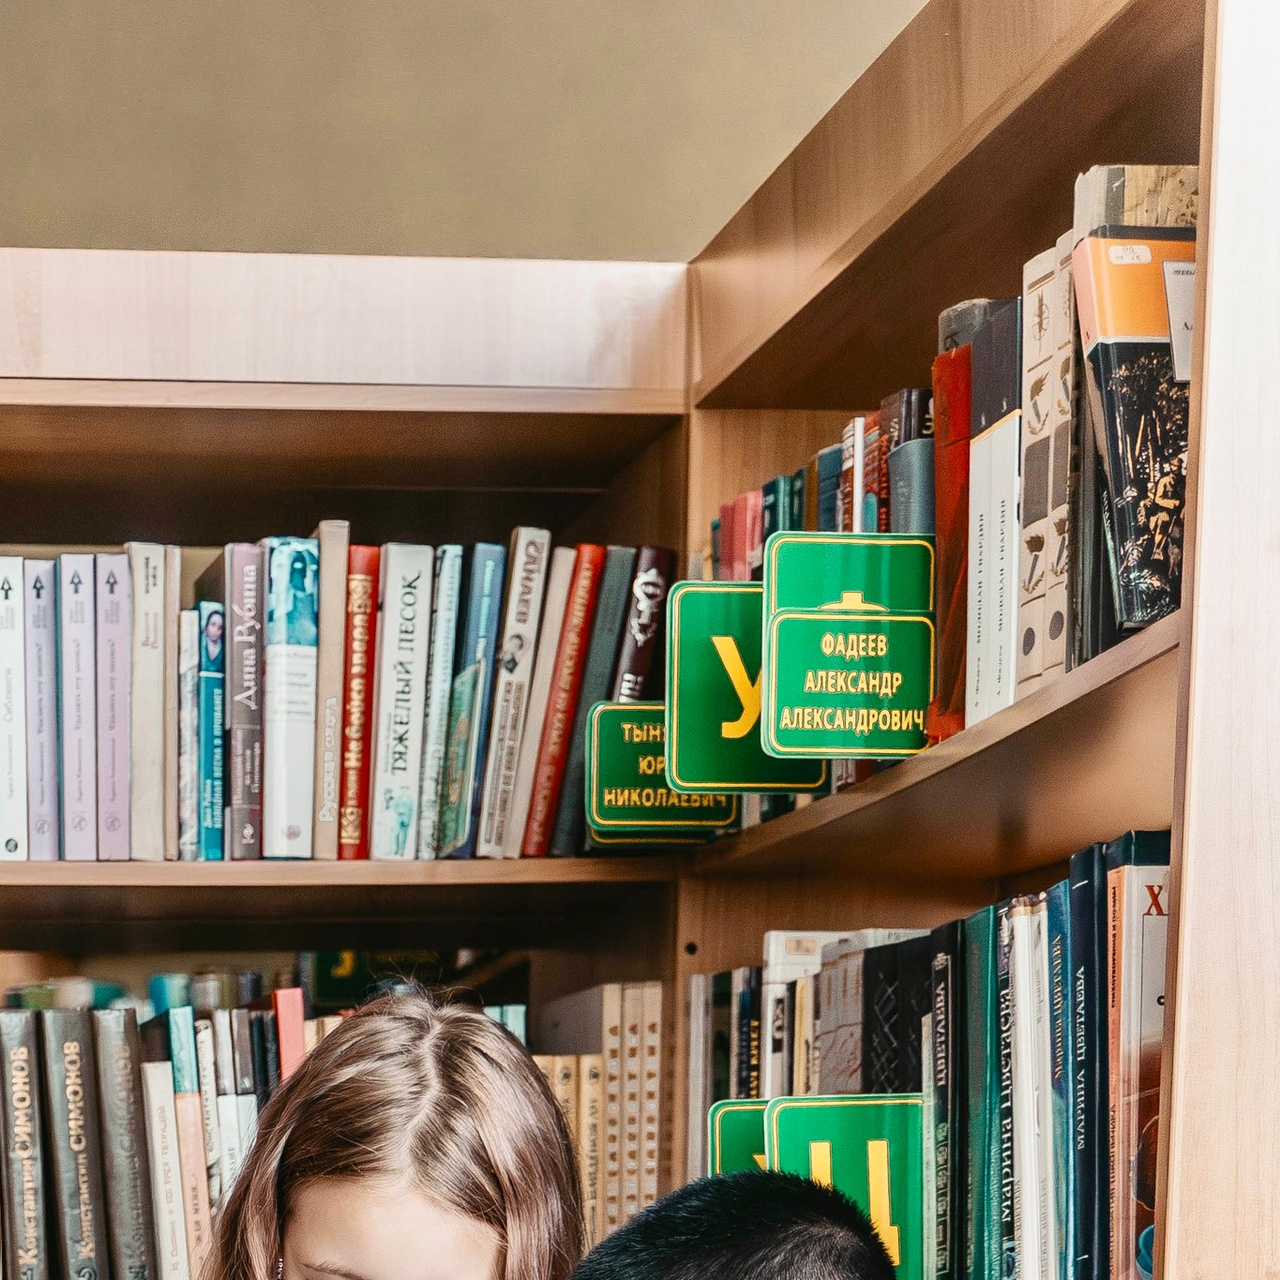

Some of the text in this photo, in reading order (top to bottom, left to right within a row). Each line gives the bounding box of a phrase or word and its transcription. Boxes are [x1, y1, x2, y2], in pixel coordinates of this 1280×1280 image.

[514, 540, 544, 625] САНАЕВ
[231, 564, 261, 710] Дина Рубина
[391, 571, 421, 776] ТЯЖЕЛЫЙ ПЕСОК
[821, 632, 888, 661] ФАДЕЕВ
[345, 677, 366, 739] бойся
[780, 708, 924, 736] АЛЕКСАНДРОВИЧ
[804, 671, 904, 699] АЛЕКСАНДР
[344, 741, 360, 769] Не
[621, 722, 666, 742] ТЫН
[318, 750, 338, 823] Русская
[604, 787, 727, 807] НИКОЛАЕВИЧ
[934, 981, 947, 1086] ЦВЕТАЕВА
[1051, 935, 1064, 1079] Марина ЦВЕТАЕВА
[1074, 966, 1086, 1150] МАРИНА ЦВЕТАЕВА
[1000, 987, 1014, 1223] Марина Цветаева
[10, 1046, 39, 1265] Константин СИМОНОВ
[63, 1041, 96, 1258] Константин СИМОНОВ
